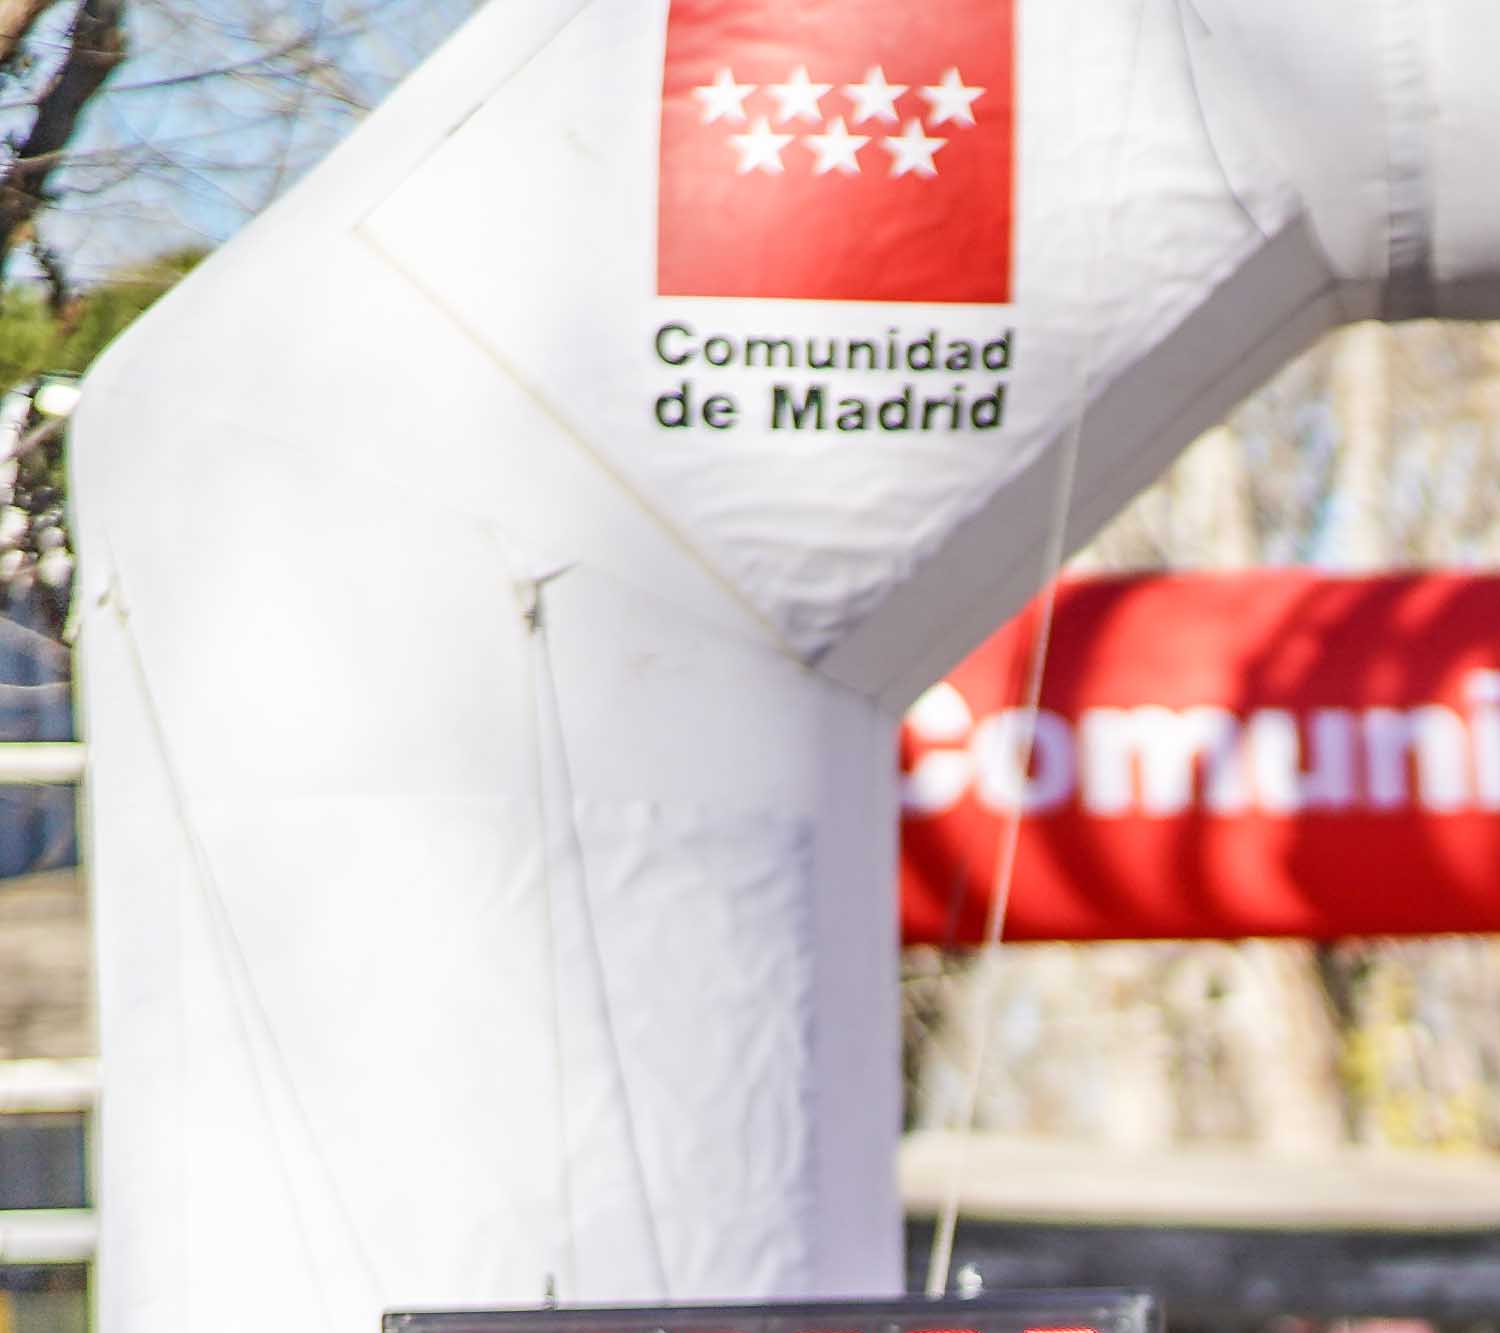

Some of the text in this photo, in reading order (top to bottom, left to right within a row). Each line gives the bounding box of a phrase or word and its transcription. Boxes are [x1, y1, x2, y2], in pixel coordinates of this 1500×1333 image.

[654, 321, 1014, 371] Comunidad
[654, 380, 1008, 431] de Madrid
